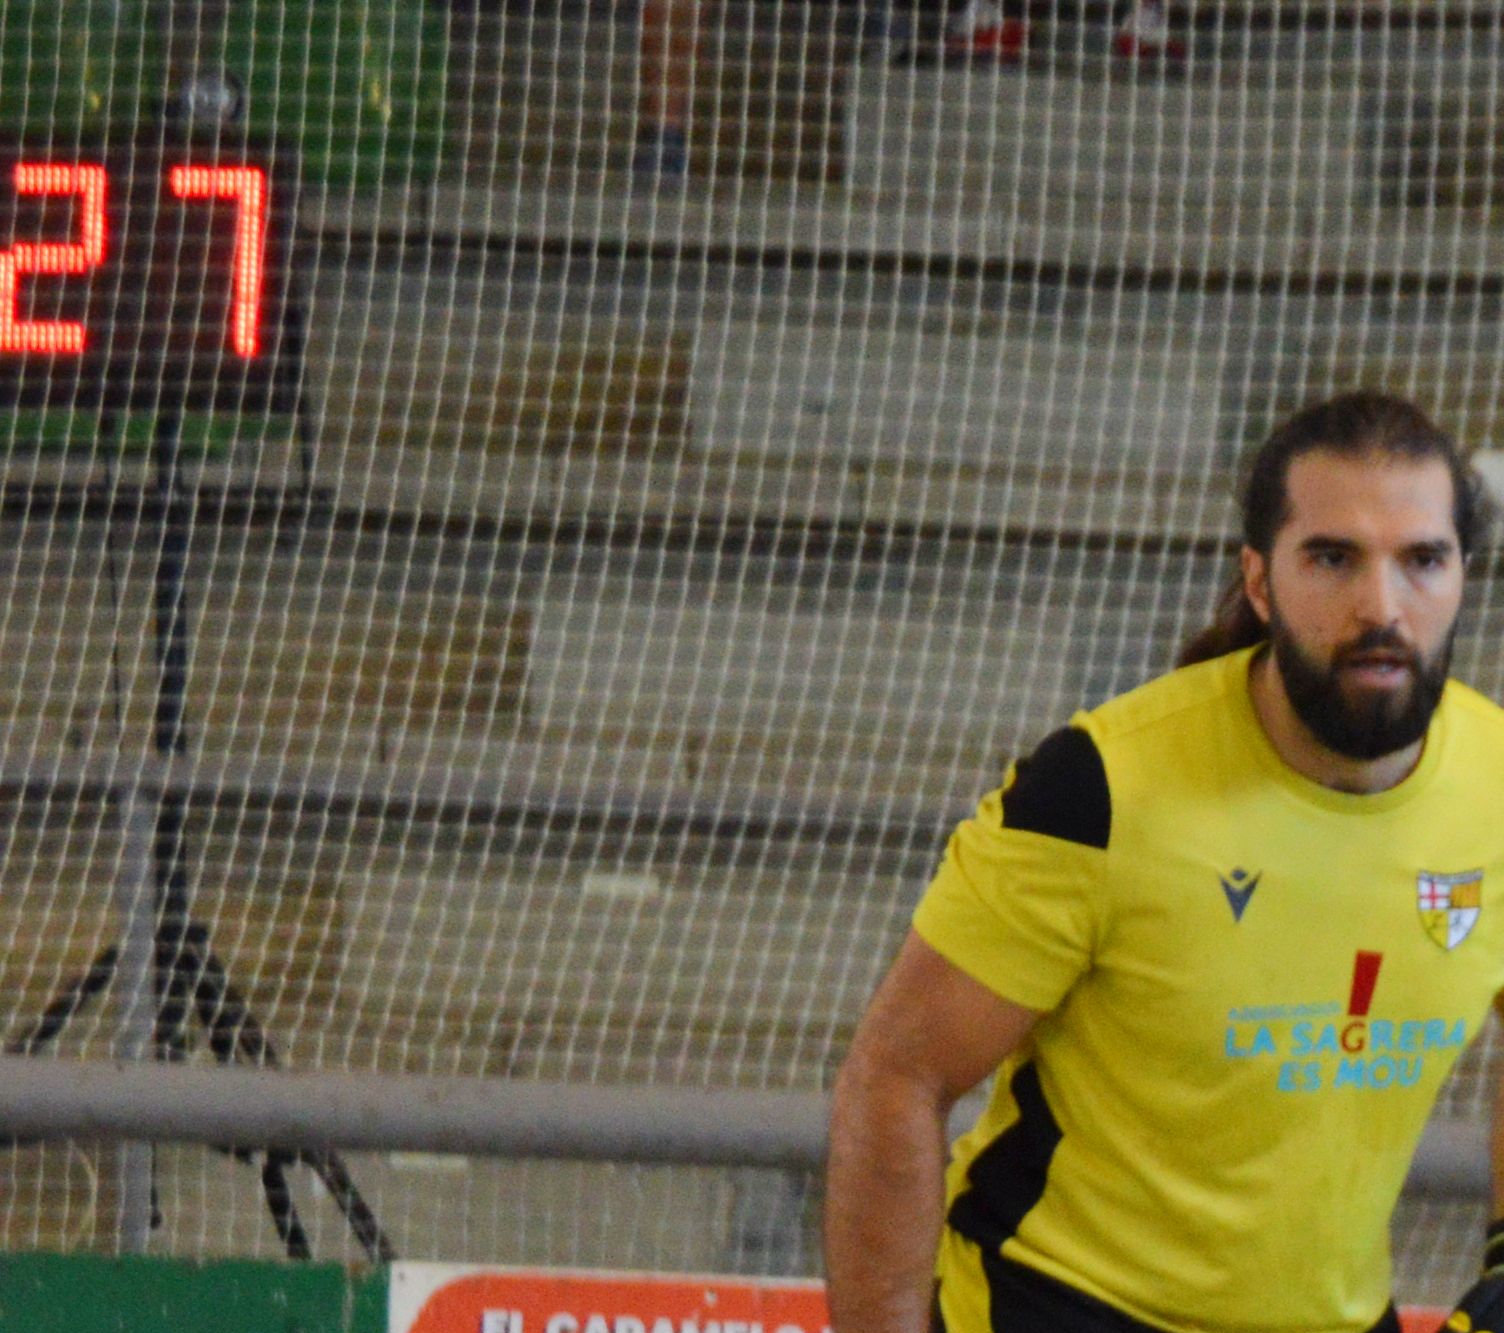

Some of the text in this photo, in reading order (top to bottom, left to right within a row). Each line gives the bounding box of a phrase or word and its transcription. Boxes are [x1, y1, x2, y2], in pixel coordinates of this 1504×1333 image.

[1224, 1024, 1276, 1058] LA
[1276, 1055, 1424, 1092] ES MOU
